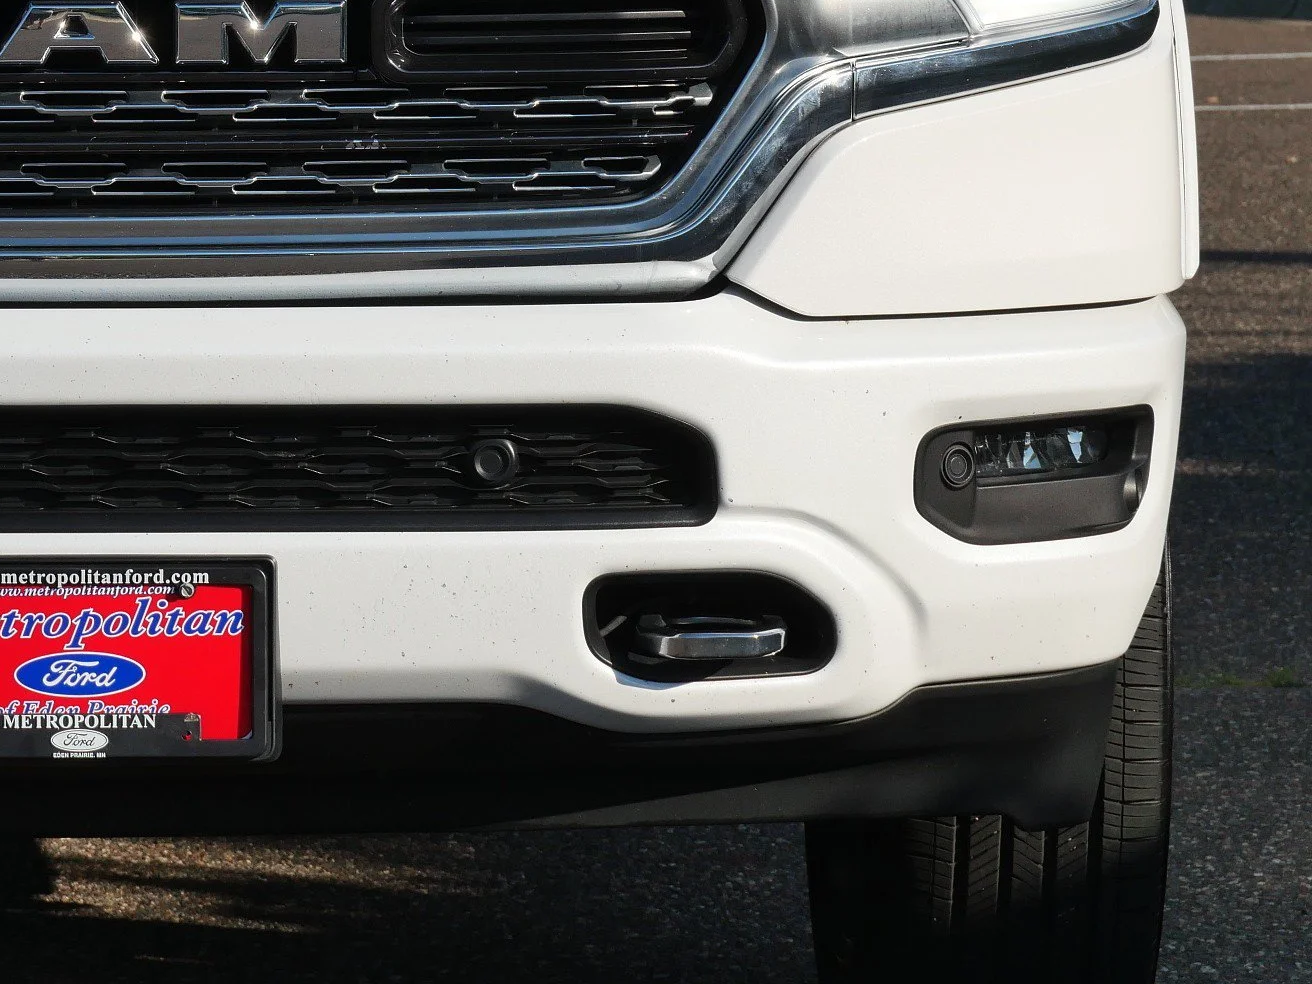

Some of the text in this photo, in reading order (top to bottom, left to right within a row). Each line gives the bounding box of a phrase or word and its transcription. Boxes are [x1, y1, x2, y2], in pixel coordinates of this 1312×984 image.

[42, 659, 118, 687] Ford
[2, 713, 157, 730] METROPOLITAN
[63, 732, 96, 747] Ford
